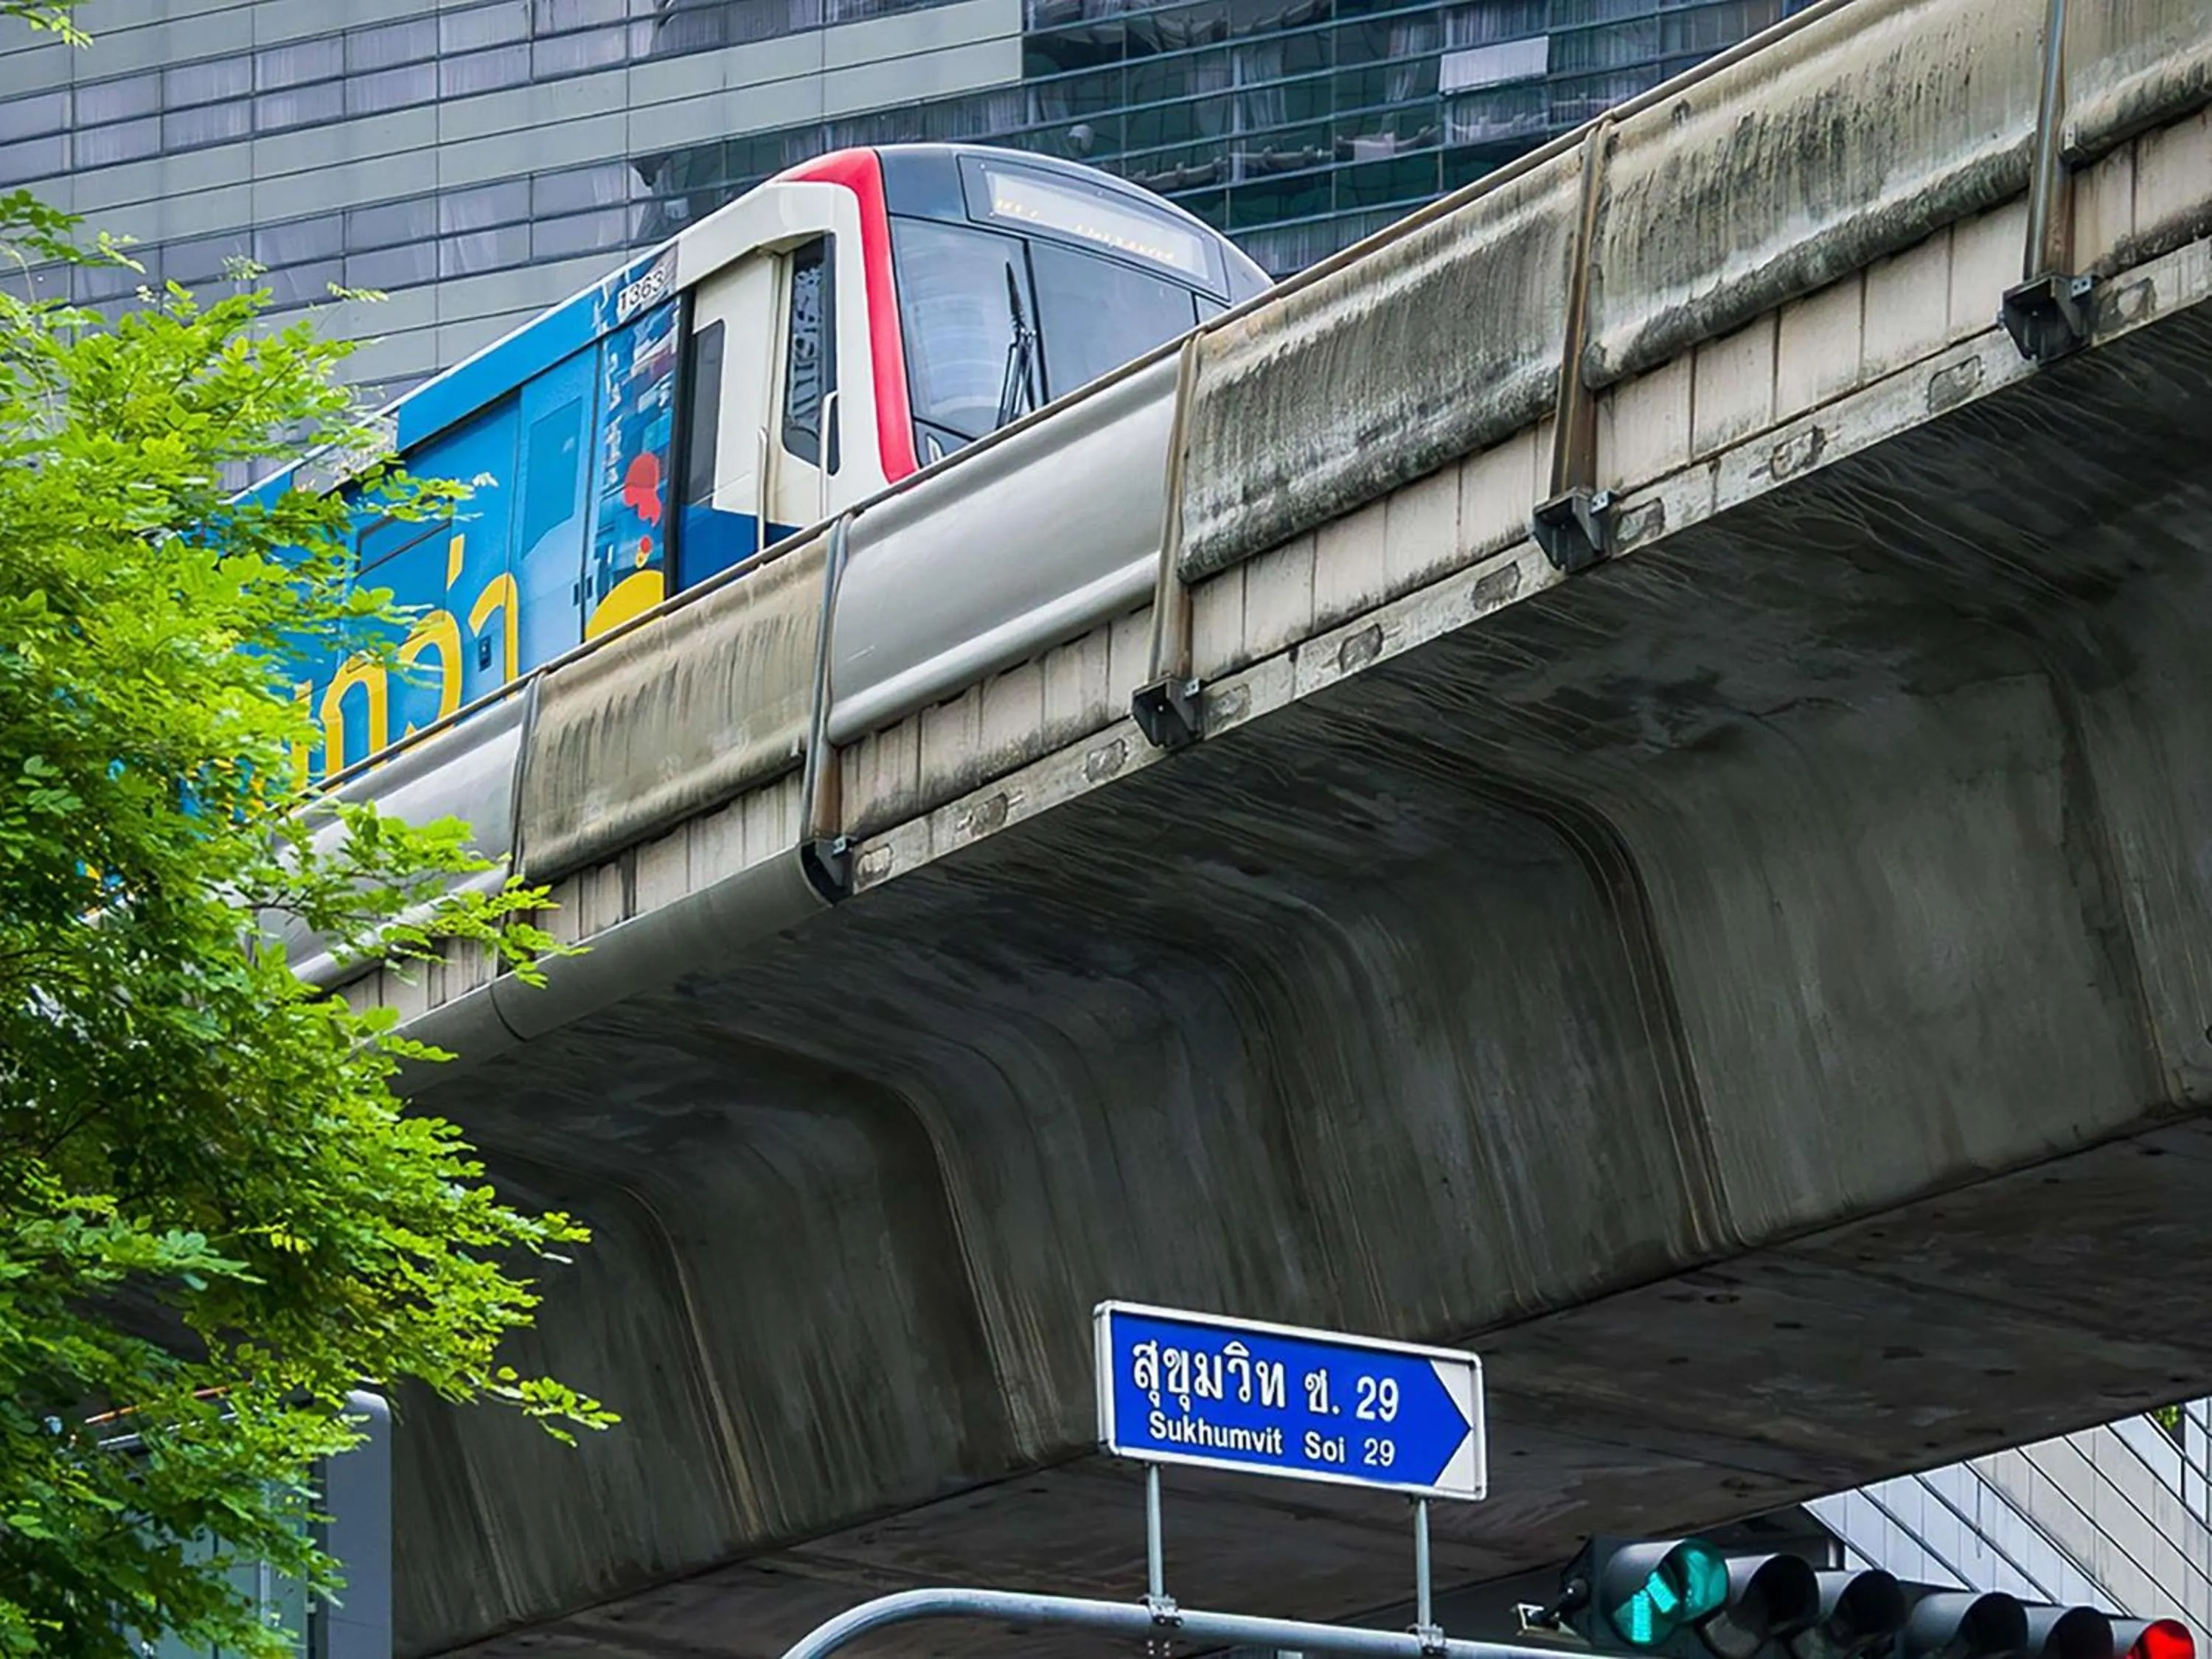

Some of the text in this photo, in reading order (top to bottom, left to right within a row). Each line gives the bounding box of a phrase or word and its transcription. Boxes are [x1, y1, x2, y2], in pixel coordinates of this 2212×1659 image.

[621, 270, 664, 310] 1363
[1132, 1340, 1286, 1411] สุขุมวิท
[1355, 1376, 1399, 1422] 29
[1149, 1410, 1396, 1467] Sukhumvit Soi 29
